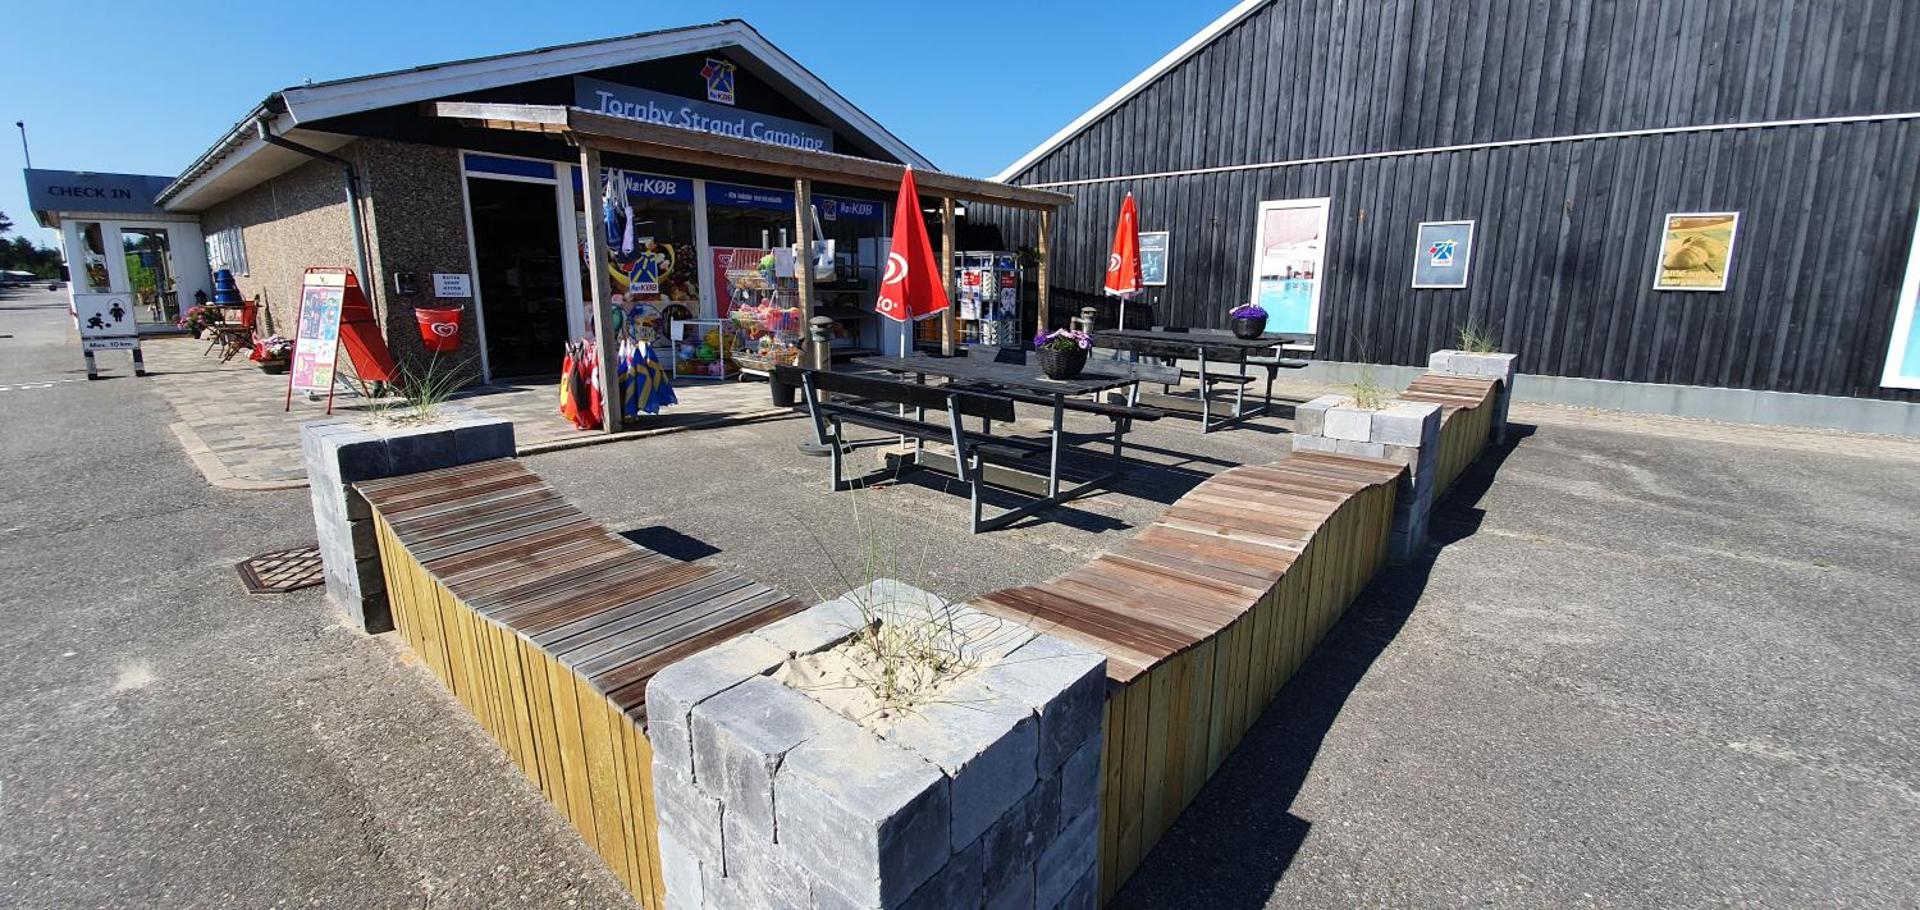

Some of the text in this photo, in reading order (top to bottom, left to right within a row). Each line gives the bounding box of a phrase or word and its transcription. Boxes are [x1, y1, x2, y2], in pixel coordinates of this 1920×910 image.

[595, 90, 824, 150] Tornby Strand Camping
[48, 185, 132, 199] CHECK IN
[625, 176, 677, 195] NærKØB
